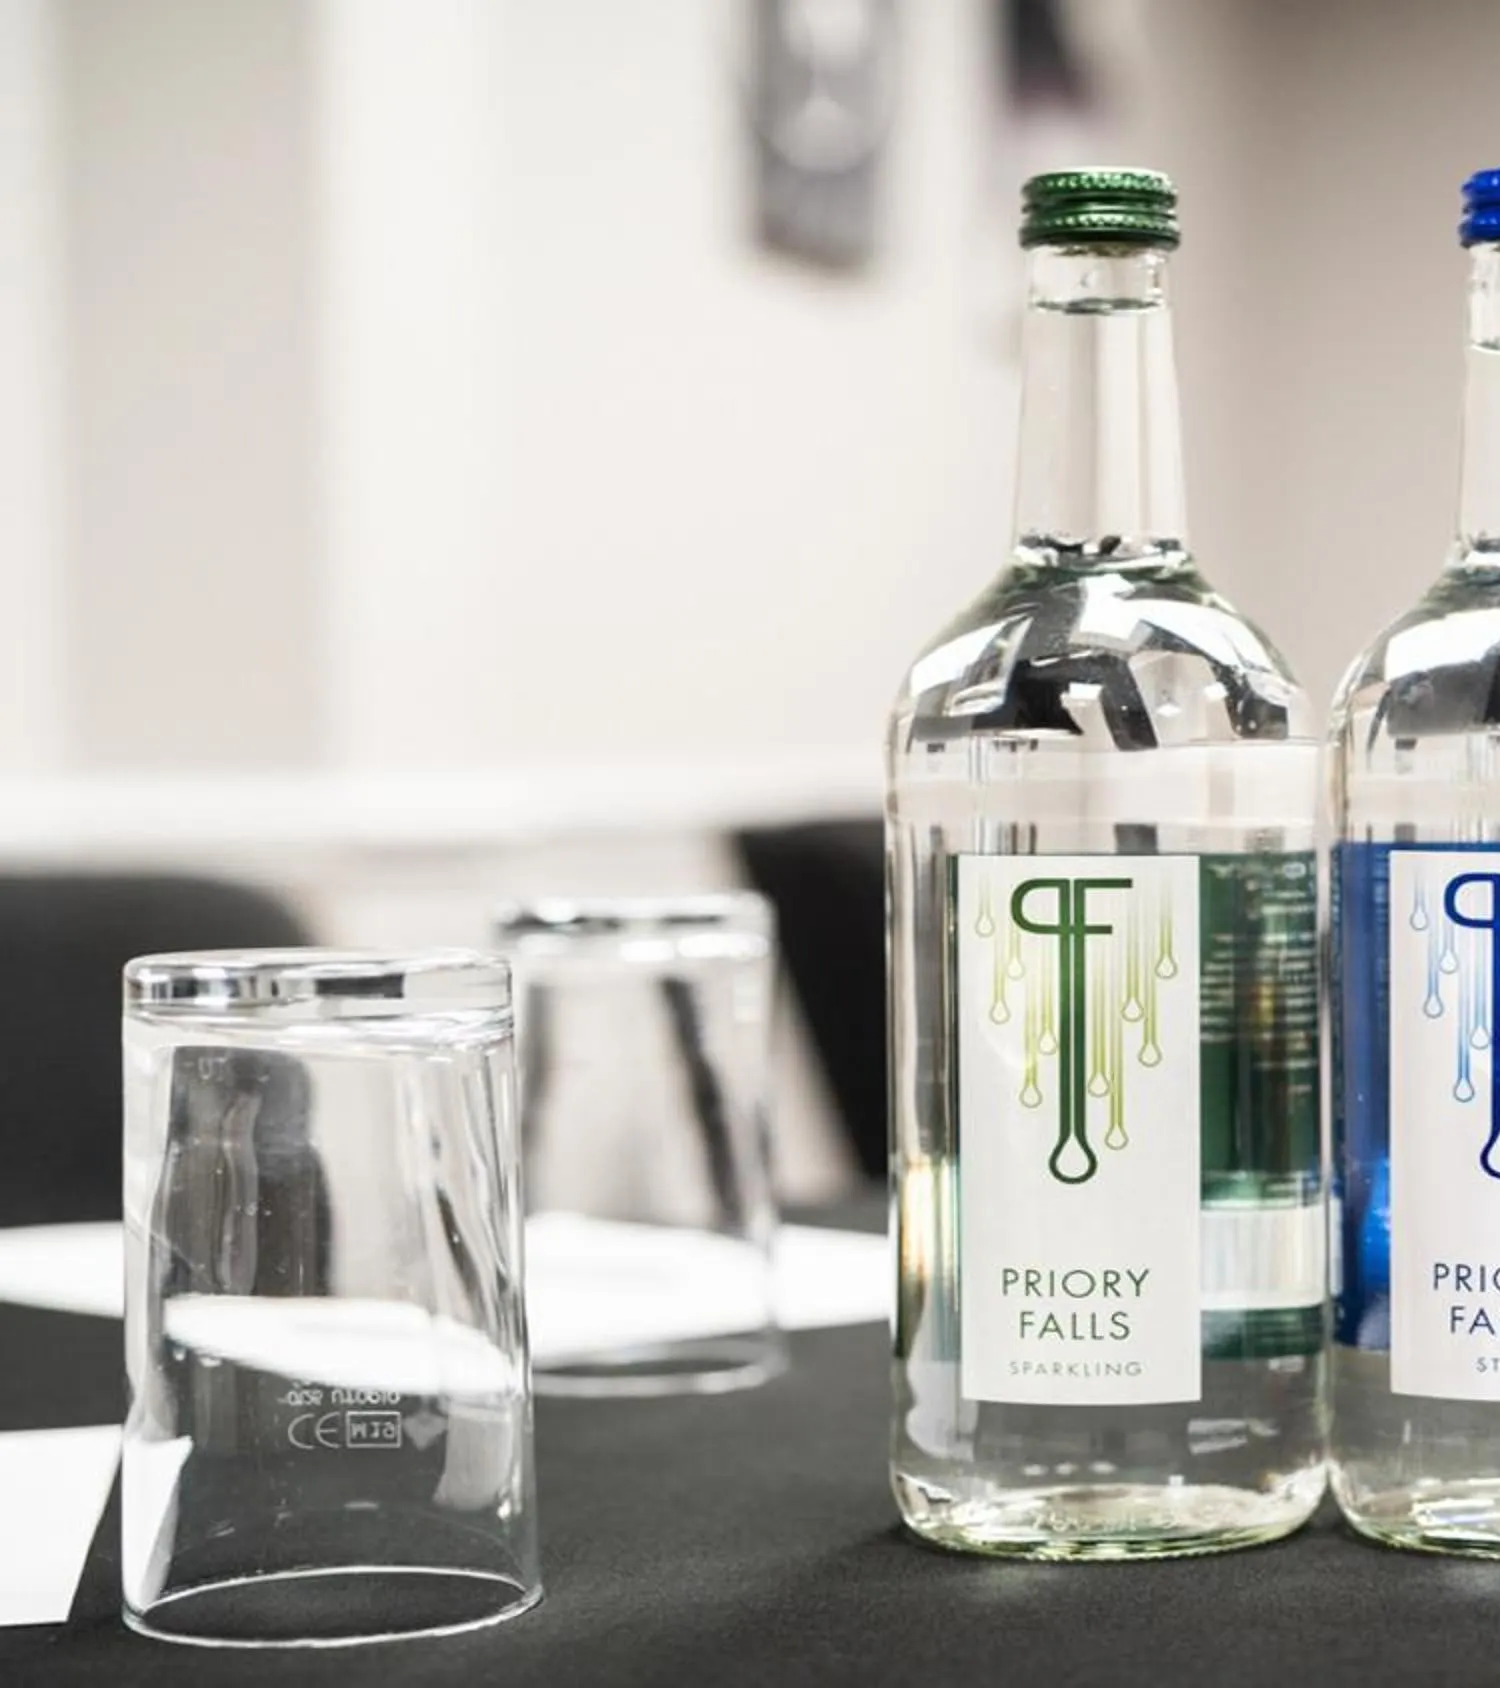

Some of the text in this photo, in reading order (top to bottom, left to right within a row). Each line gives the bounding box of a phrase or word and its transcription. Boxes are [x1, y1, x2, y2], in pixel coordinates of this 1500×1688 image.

[1001, 1267, 1150, 1299] PRIORY
[1019, 1310, 1131, 1341] FALLS
[1009, 1361, 1143, 1377] SPARKLING
